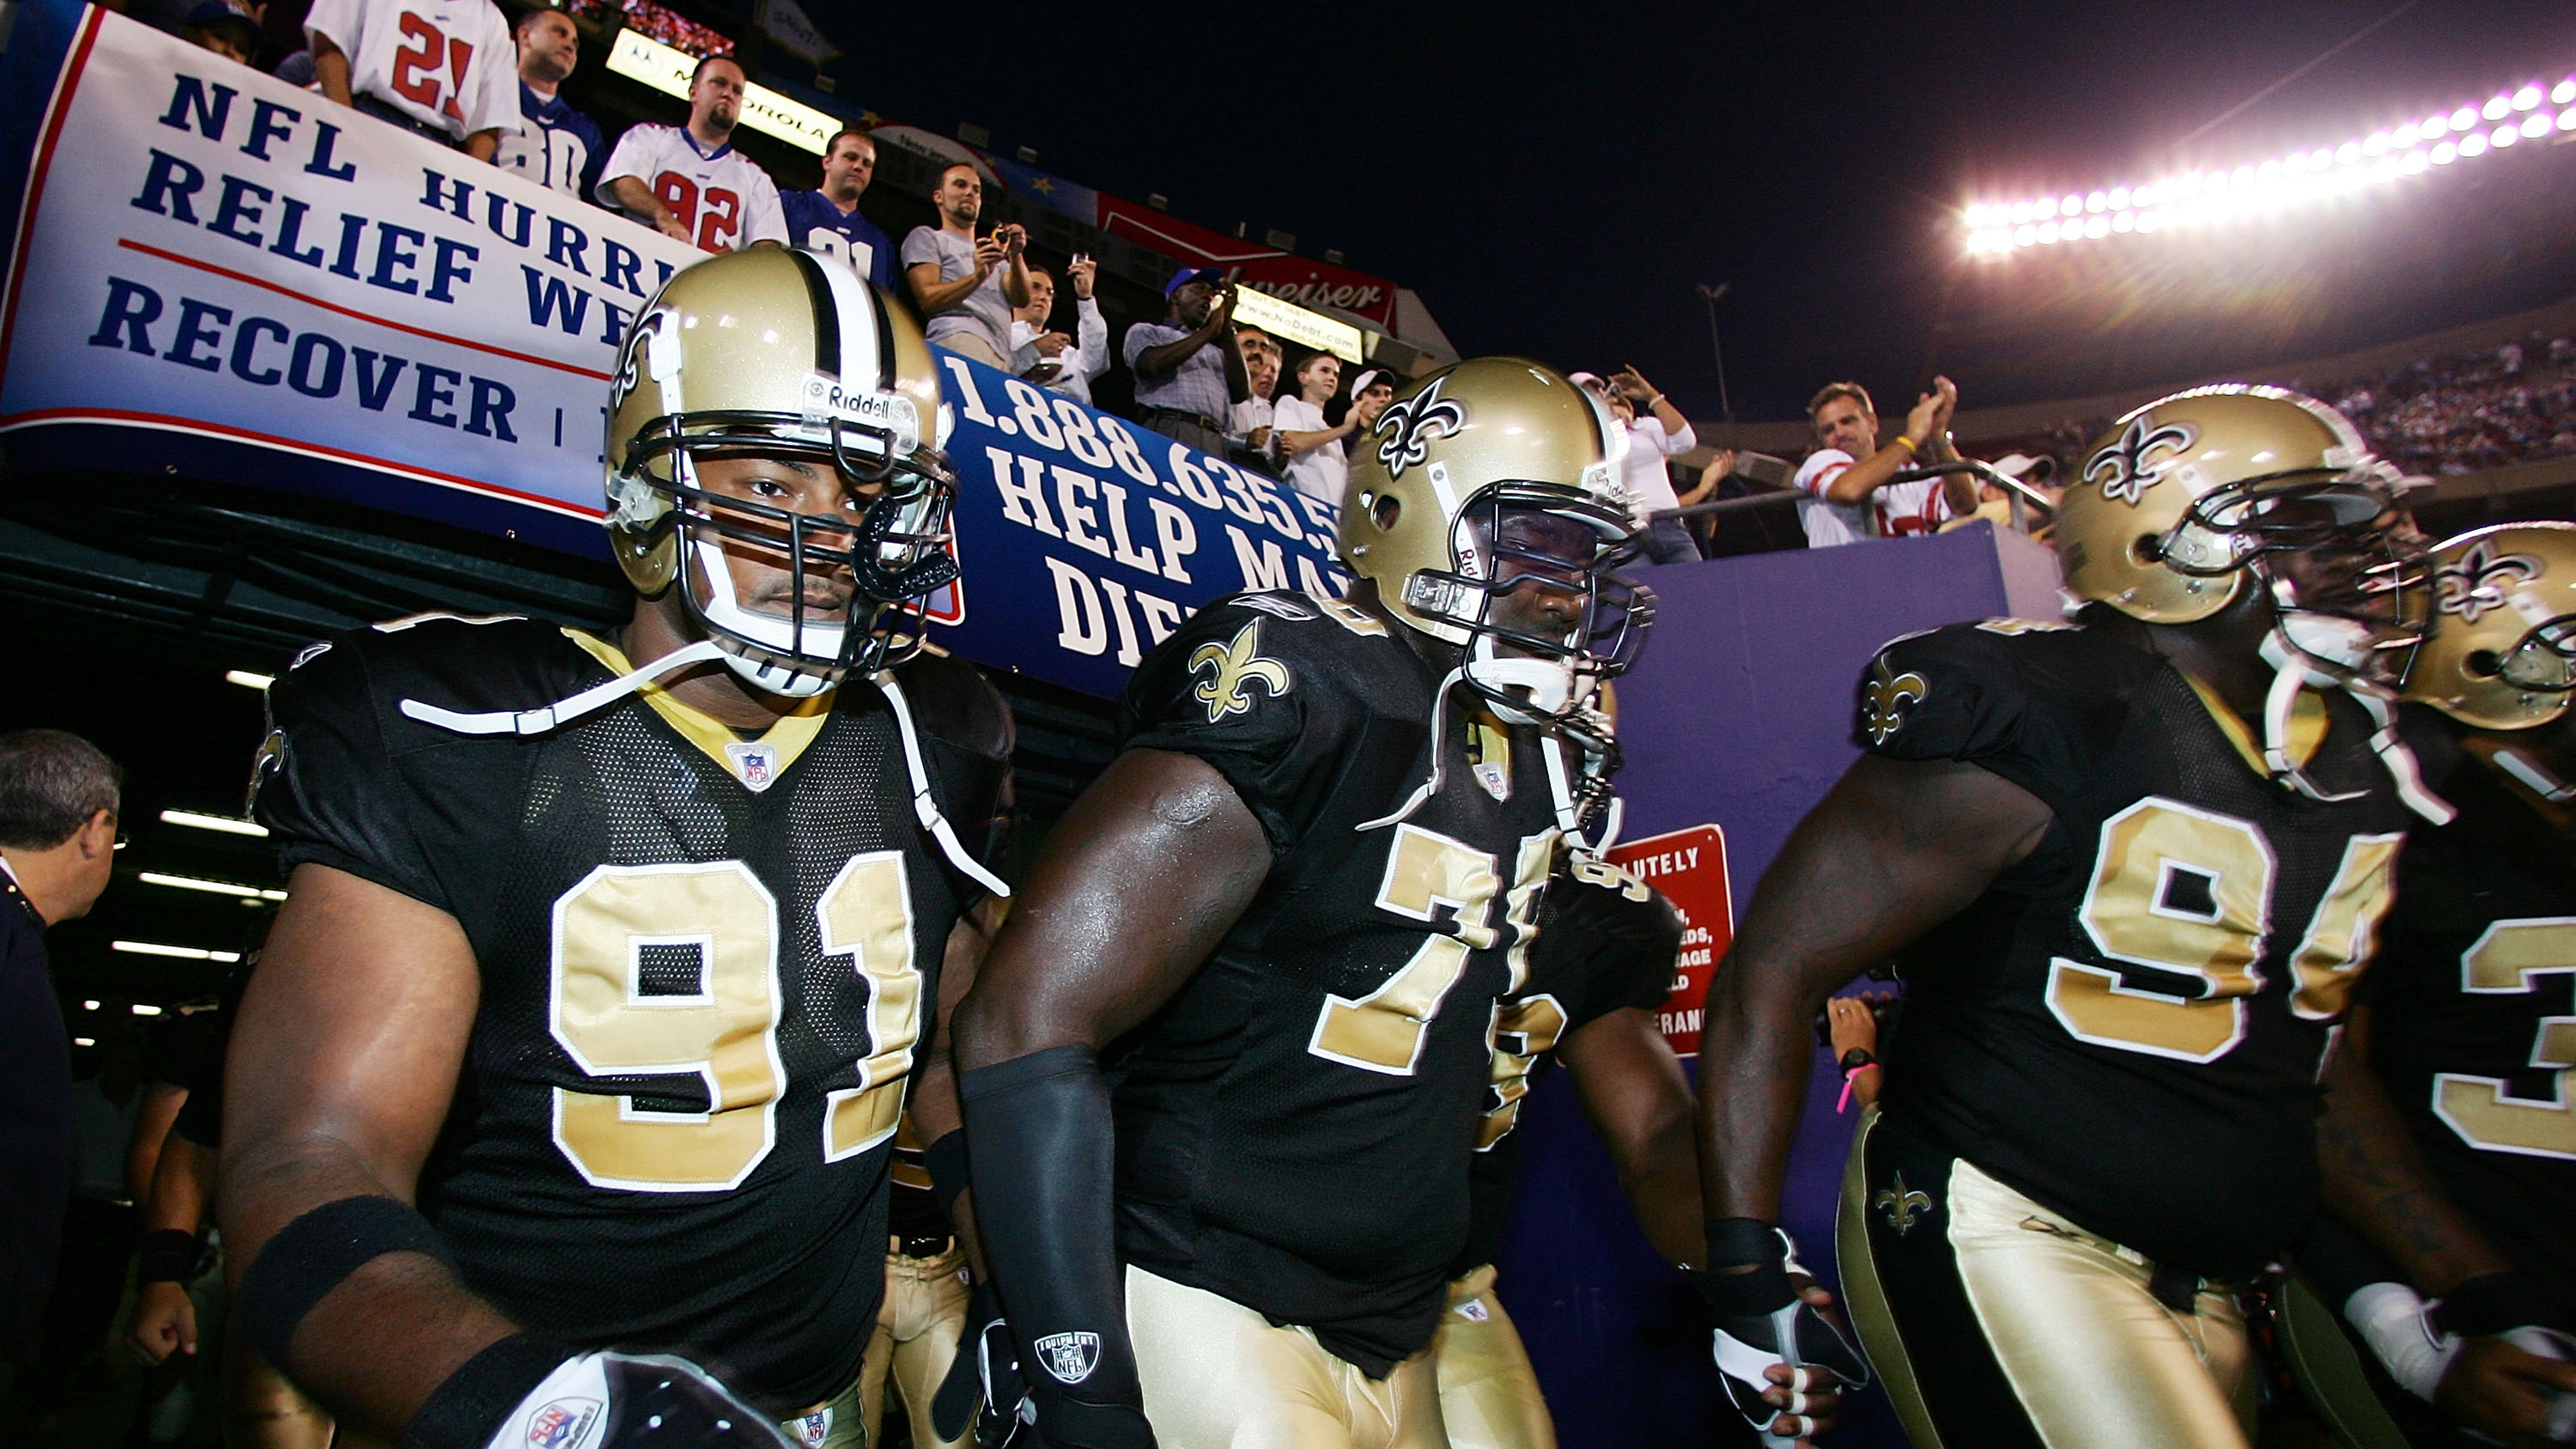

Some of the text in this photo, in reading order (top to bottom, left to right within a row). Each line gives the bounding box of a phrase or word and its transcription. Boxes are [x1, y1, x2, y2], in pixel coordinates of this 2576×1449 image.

[391, 11, 473, 125] 21
[674, 70, 825, 140] MOROLA
[158, 73, 357, 182] NFL
[130, 147, 480, 304] RELIEF
[654, 171, 739, 256] 92
[88, 277, 518, 443] RECOVER
[829, 385, 889, 419] Riddell
[943, 356, 1342, 555] 1.888.635.5
[986, 446, 1197, 584] HELP
[1045, 555, 1198, 668] DIF
[549, 851, 923, 1191] 91
